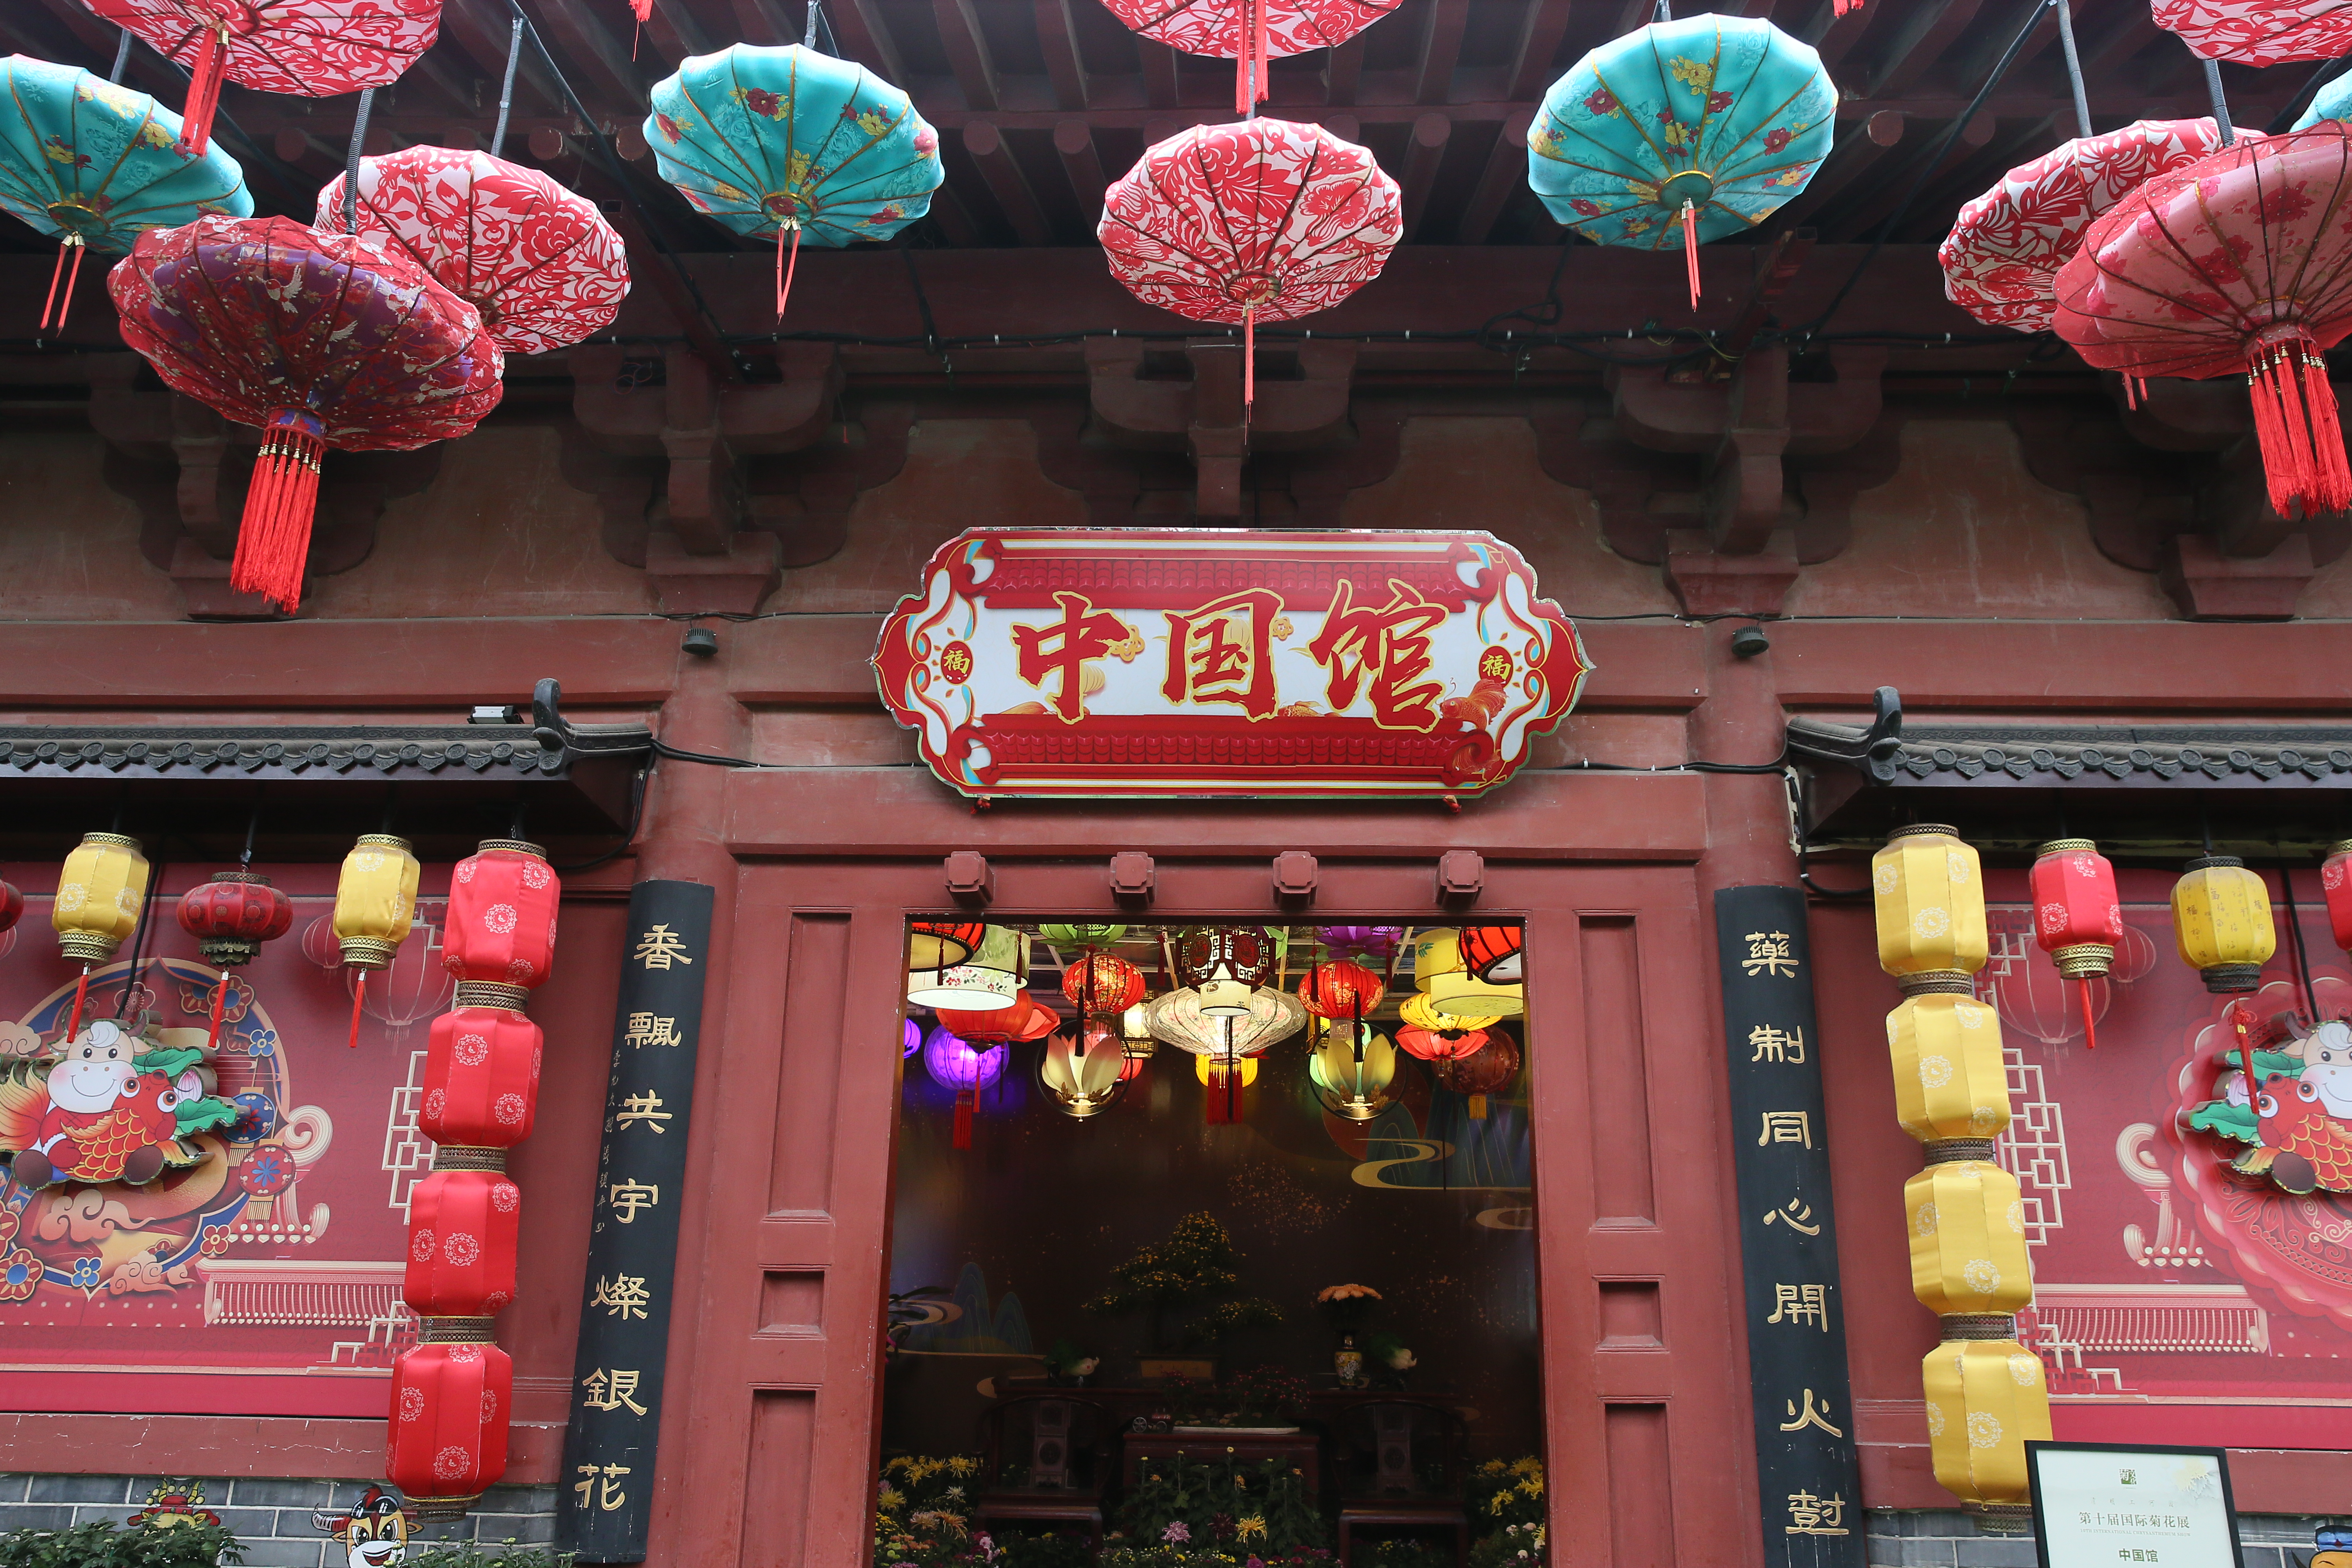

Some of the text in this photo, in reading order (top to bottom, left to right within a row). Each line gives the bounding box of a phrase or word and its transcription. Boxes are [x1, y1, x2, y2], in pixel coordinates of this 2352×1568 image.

[943, 649, 970, 674] 福
[1011, 579, 1450, 733] 中国馆
[1482, 654, 1511, 681] 福
[2079, 1512, 2190, 1529] 第十届国际菊花展
[2119, 1548, 2159, 1563] 中国馆
